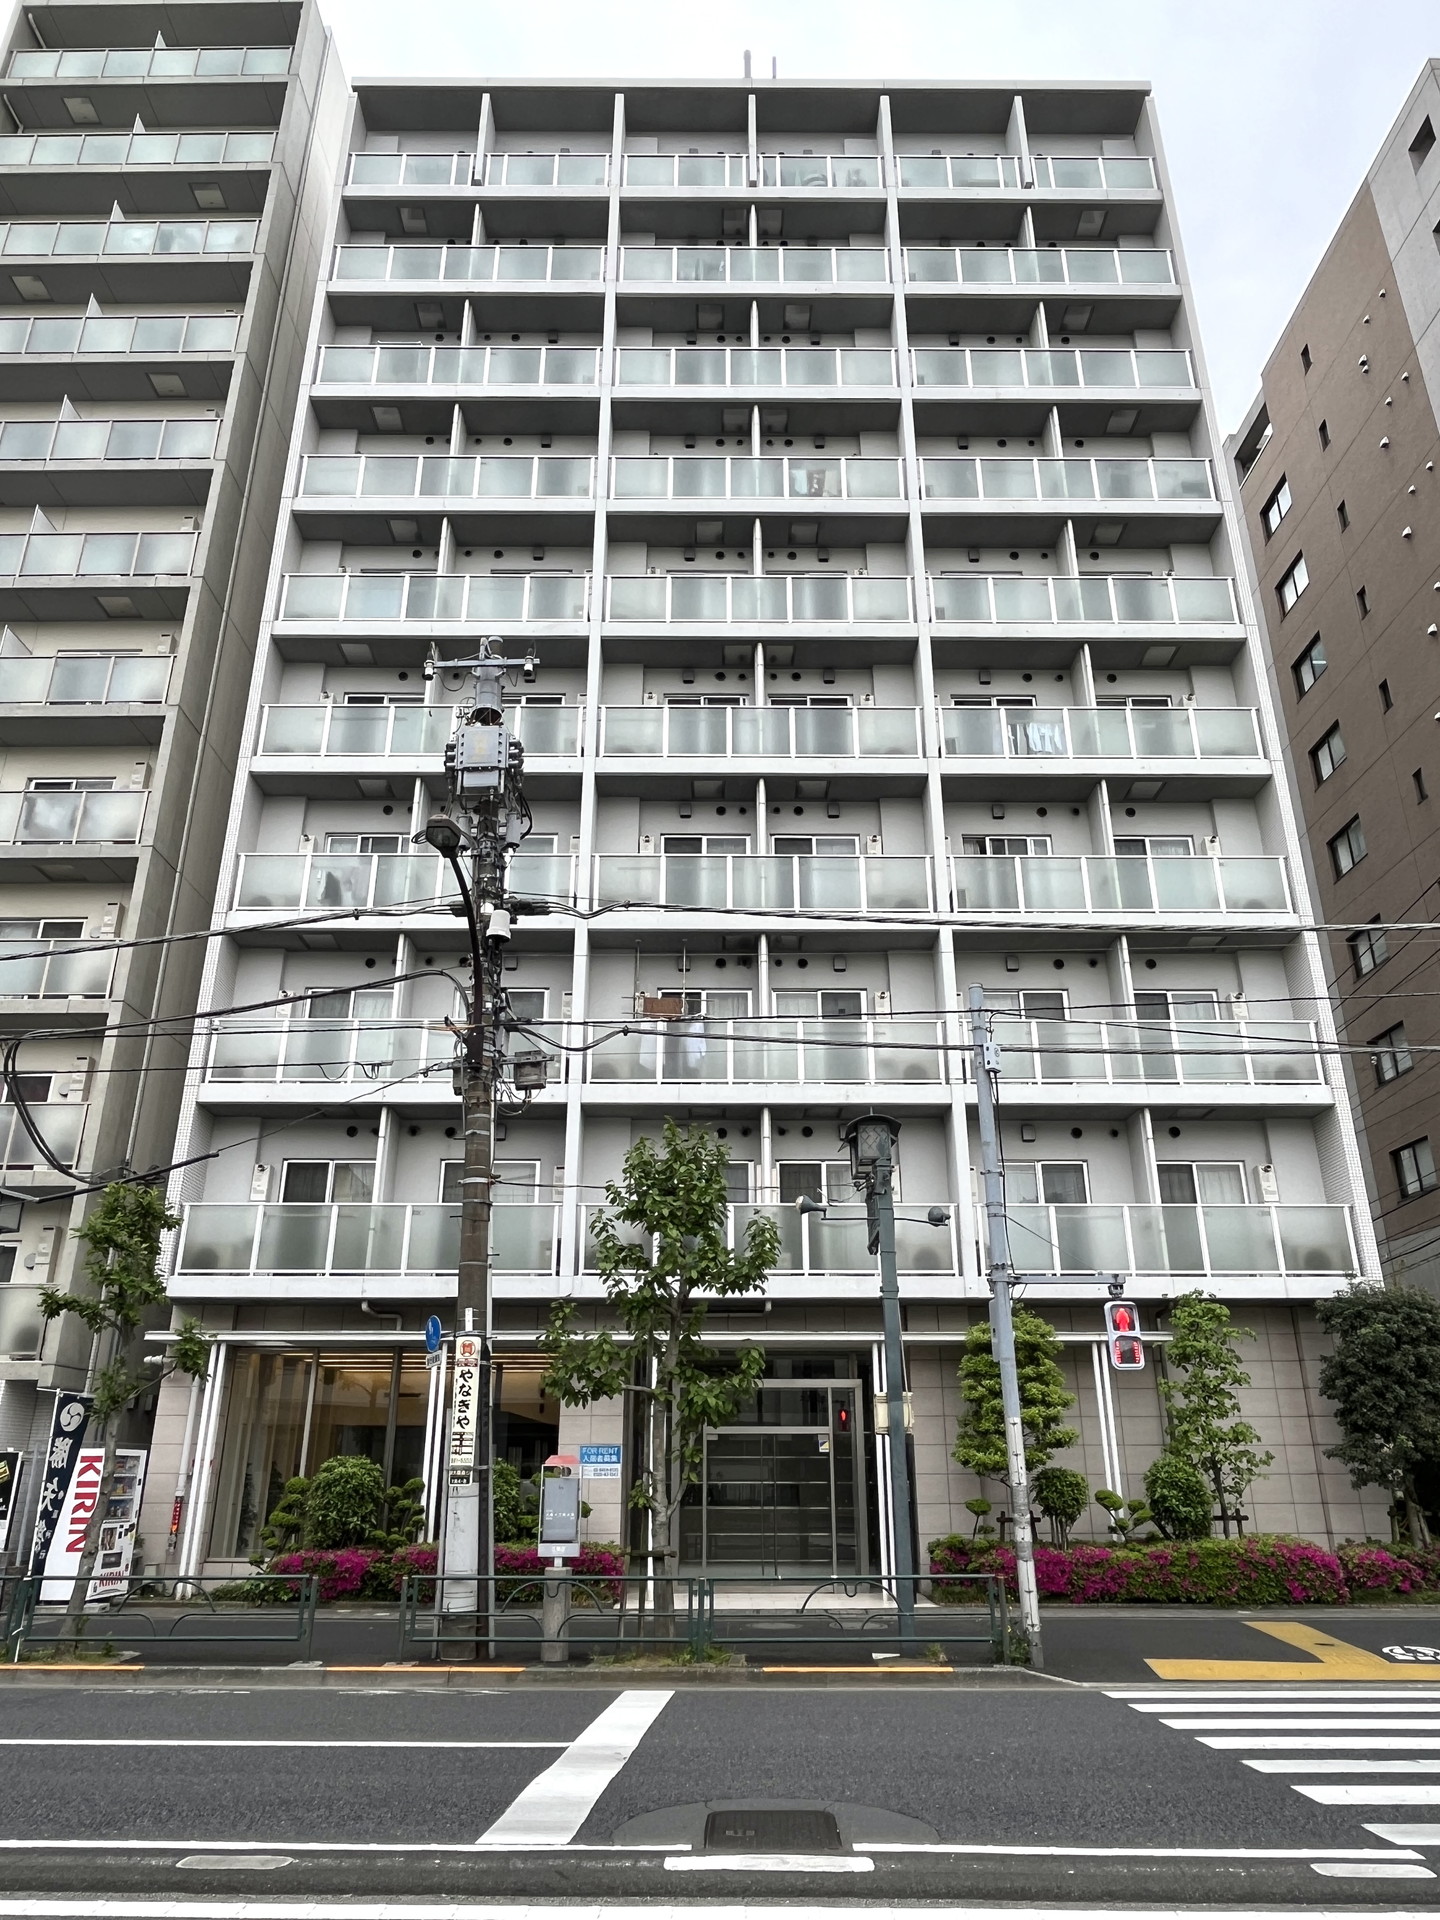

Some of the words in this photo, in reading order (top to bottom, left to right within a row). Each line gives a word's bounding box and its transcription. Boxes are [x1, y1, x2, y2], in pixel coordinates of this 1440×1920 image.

[456, 1368, 474, 1430] やなぎや
[582, 1447, 598, 1455] FOR
[599, 1447, 618, 1455] RENT
[583, 1454, 618, 1463] 入居者募集
[66, 1456, 104, 1552] KIRIN
